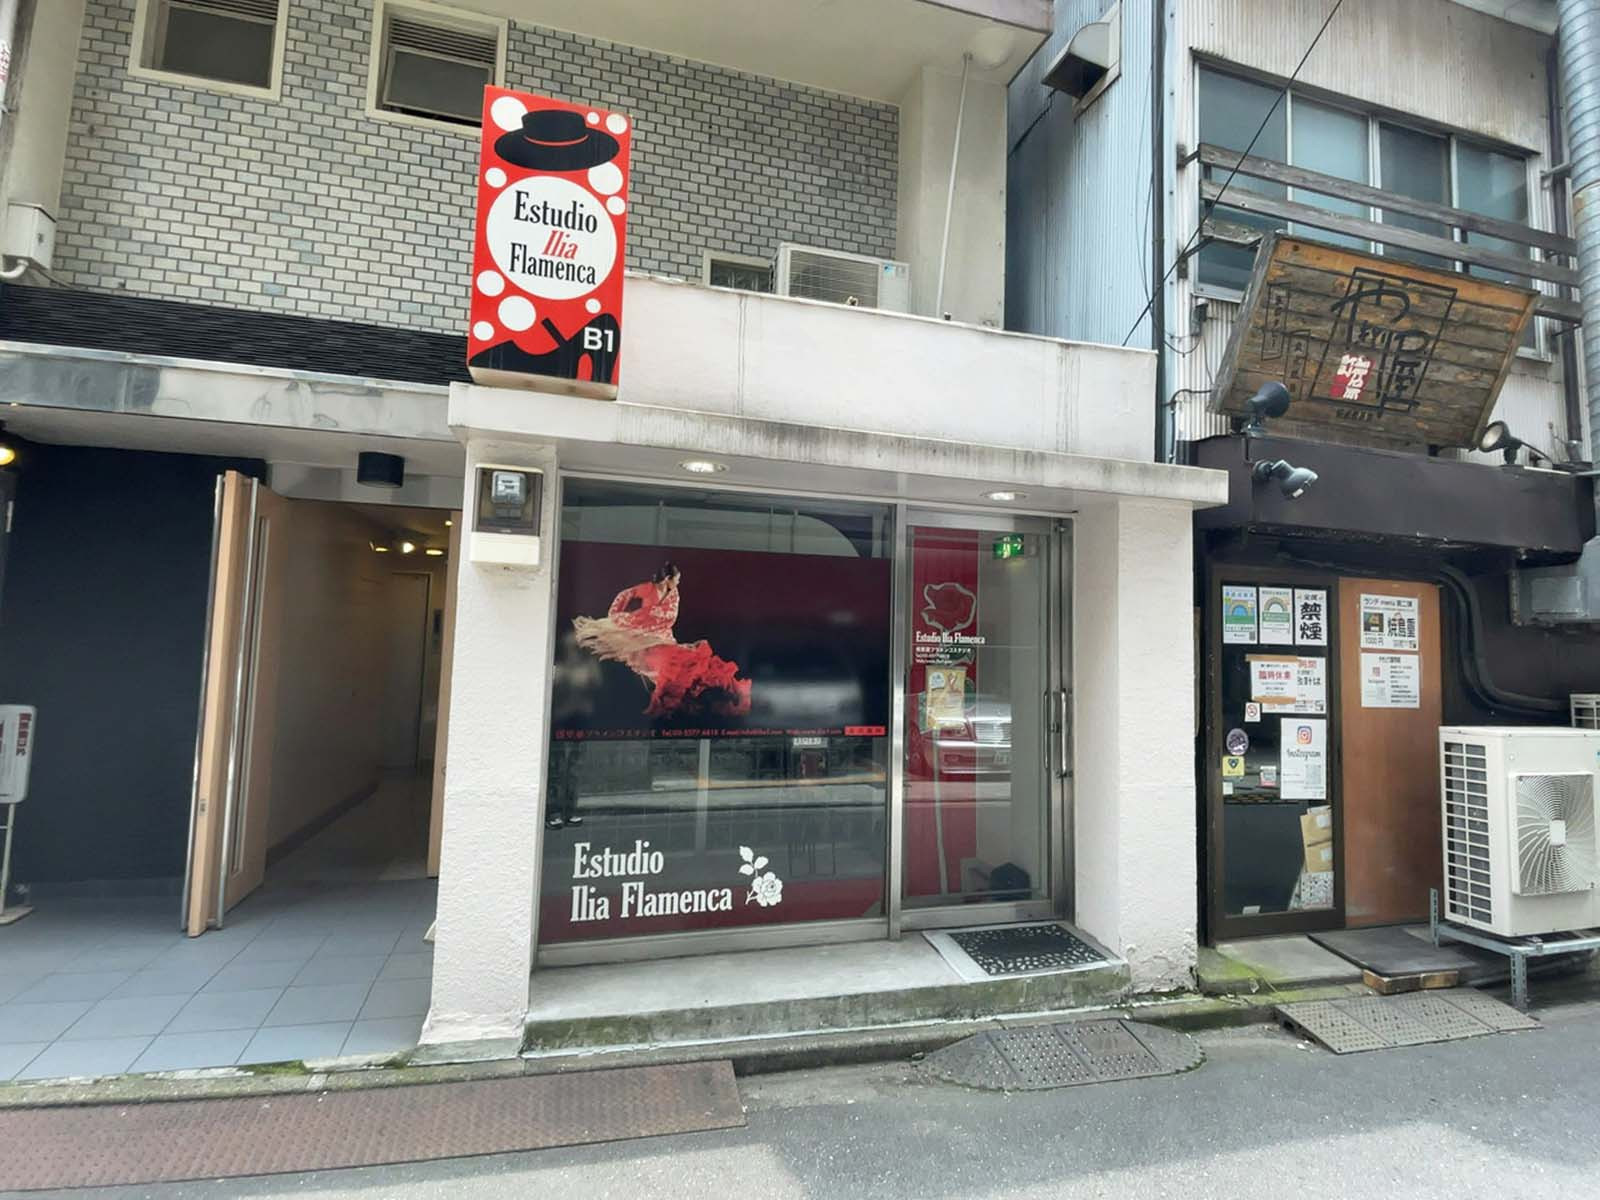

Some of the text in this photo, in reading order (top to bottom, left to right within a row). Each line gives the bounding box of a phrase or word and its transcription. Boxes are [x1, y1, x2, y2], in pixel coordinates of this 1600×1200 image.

[513, 189, 598, 234] Estudio
[509, 243, 596, 286] Flamenca
[541, 230, 579, 260] Ilia
[583, 326, 614, 353] B1
[916, 630, 941, 643] Estudio
[954, 632, 986, 644] Flamenca
[1300, 602, 1323, 640] 禁煙
[572, 839, 664, 879] Estudio
[570, 881, 733, 922] Ilia Flamenca
